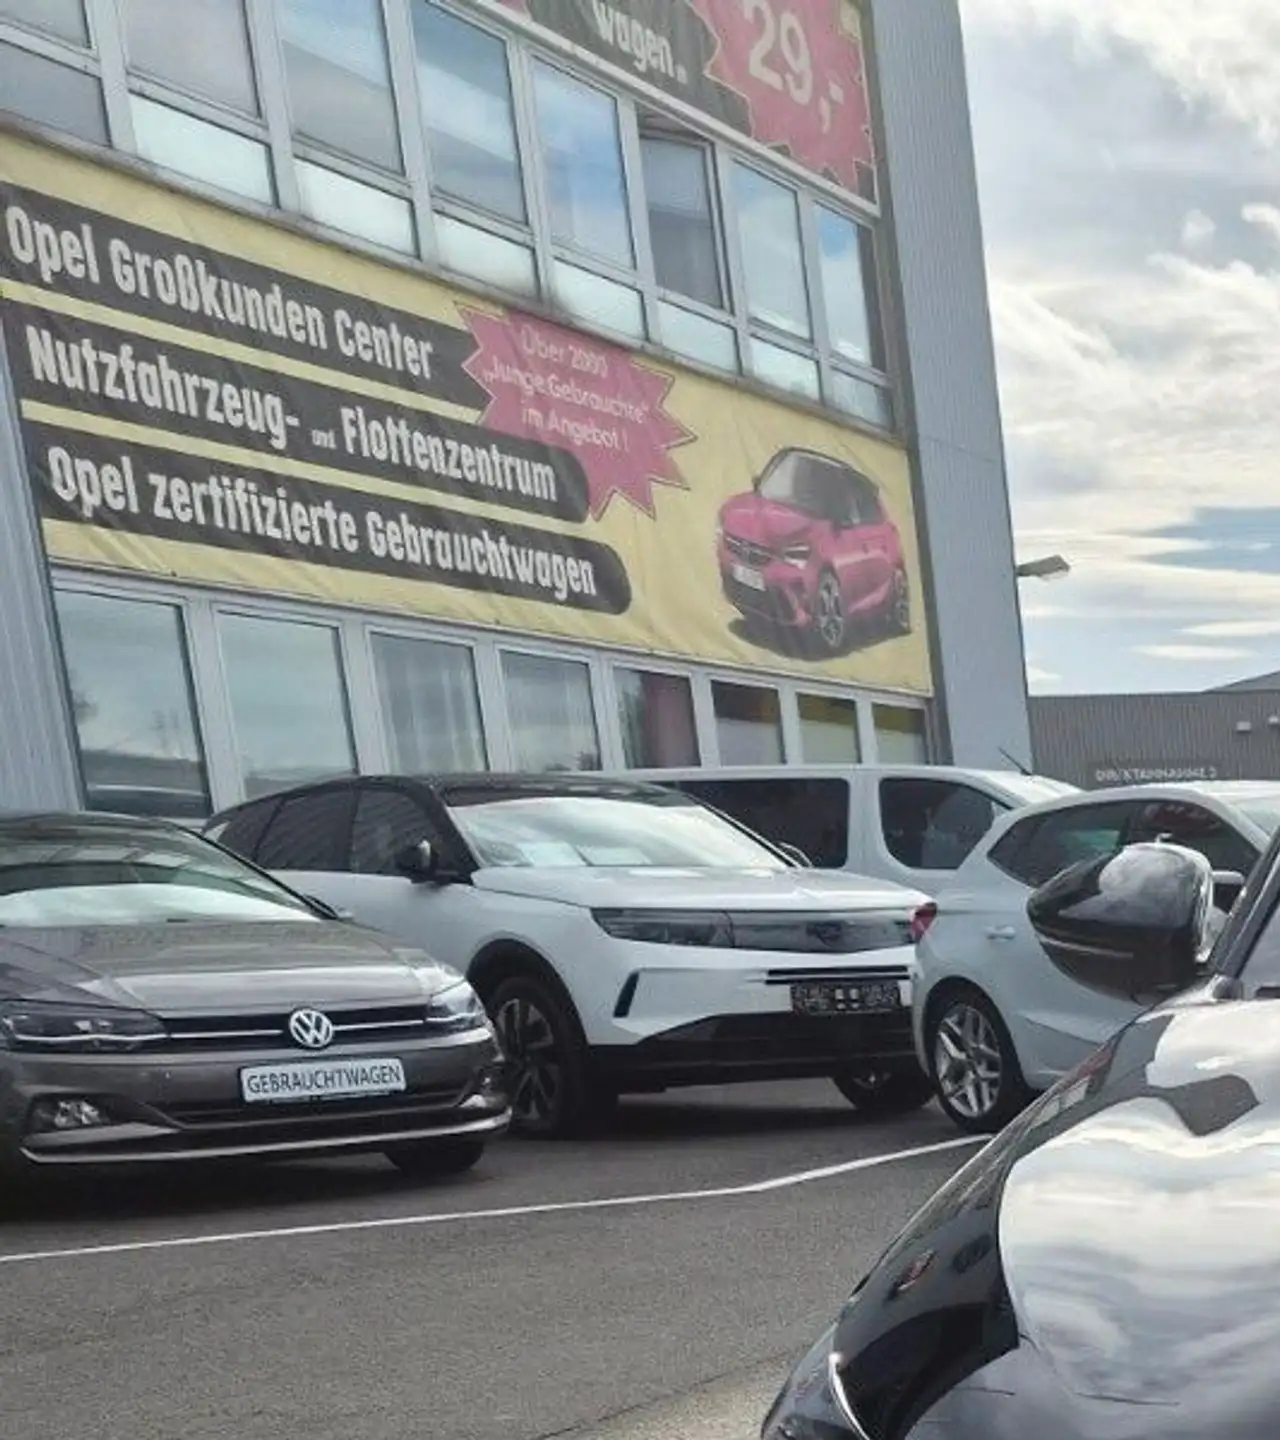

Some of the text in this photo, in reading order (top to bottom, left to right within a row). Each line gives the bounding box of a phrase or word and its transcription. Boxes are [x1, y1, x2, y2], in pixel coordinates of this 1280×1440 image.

[6, 206, 434, 380] Opel Großkunden Center
[26, 324, 300, 450] Nutzfahrzeug-
[341, 405, 558, 501] Flottenzentrum
[48, 446, 597, 600] Opel zertifizierte Gebrauchtwagen
[247, 1065, 400, 1094] GEBRAUCHTWAGEN
